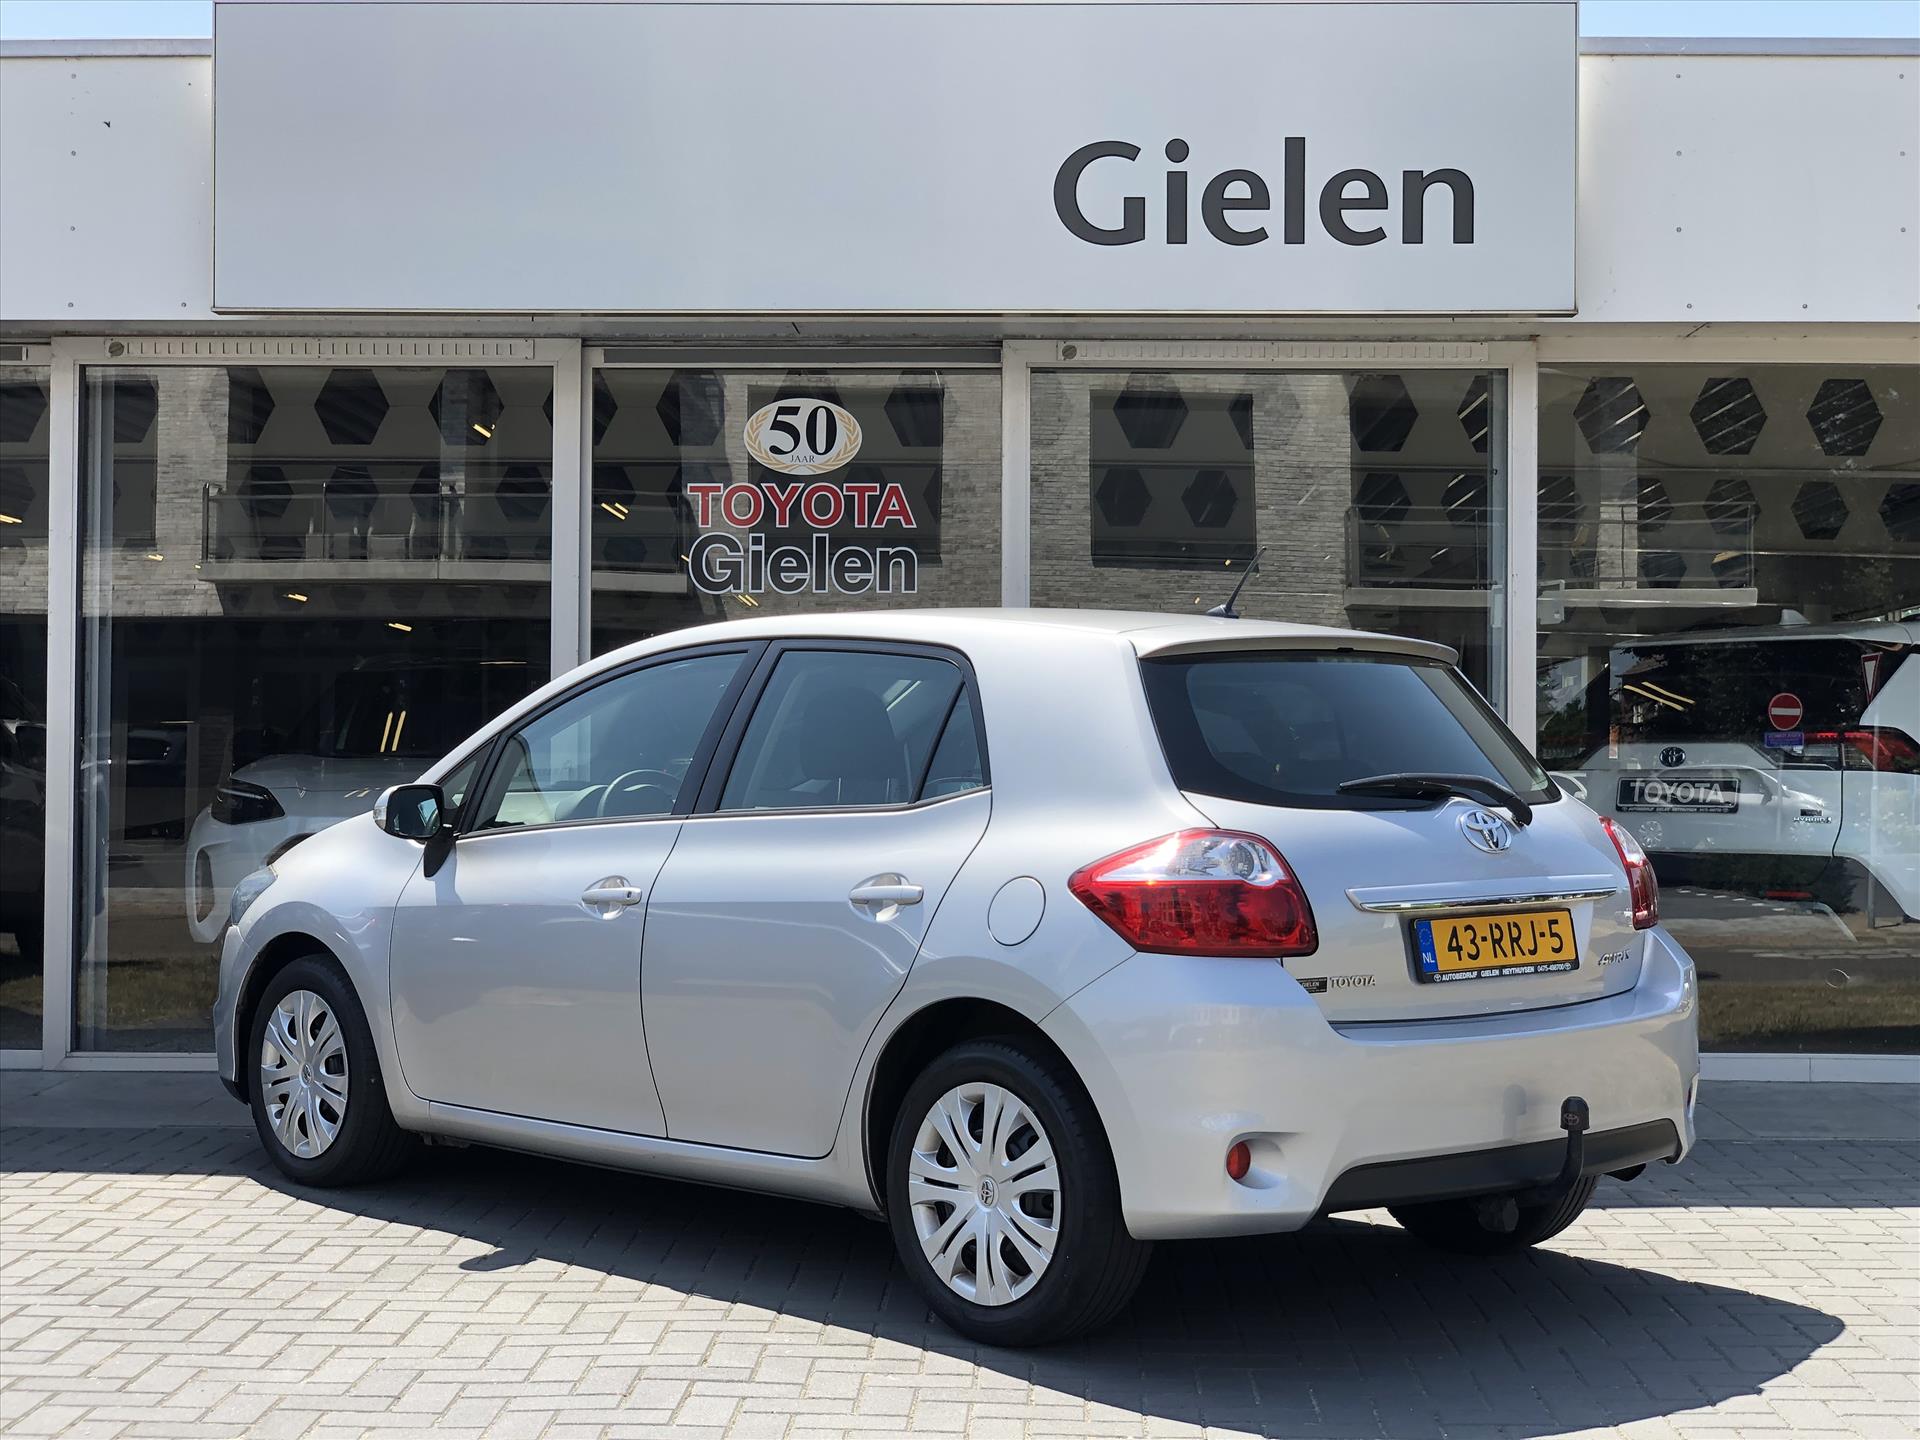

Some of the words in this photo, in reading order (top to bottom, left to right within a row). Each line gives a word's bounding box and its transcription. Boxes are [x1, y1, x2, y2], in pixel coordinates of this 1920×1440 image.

[1053, 137, 1474, 246] Gielen
[769, 405, 838, 456] 50
[790, 455, 815, 463] JAAR
[687, 483, 918, 528] TOYOTA
[688, 532, 918, 594] Gielen
[1630, 782, 1724, 803] TOYOTA
[1447, 919, 1564, 961] 43-RRJ-5
[1422, 952, 1435, 964] NL
[1329, 975, 1376, 988] TOYOTA
[1442, 970, 1478, 981] AUTOBEDRIJF
[1480, 968, 1500, 978] GIELEN
